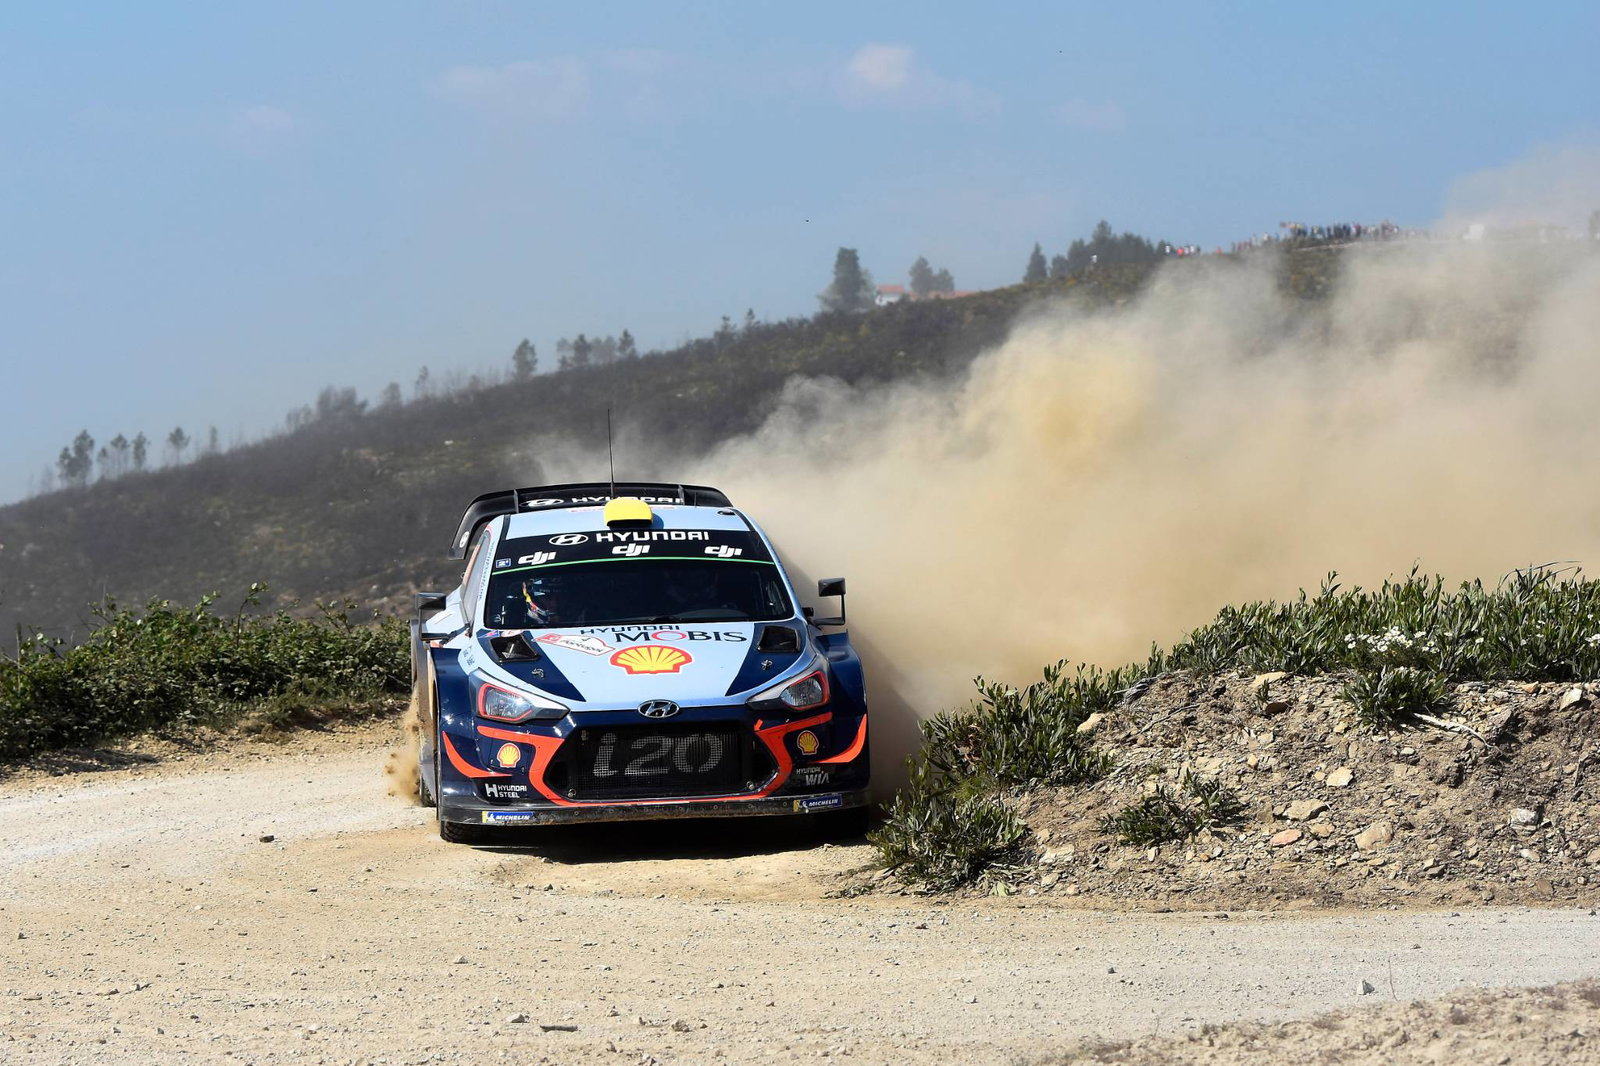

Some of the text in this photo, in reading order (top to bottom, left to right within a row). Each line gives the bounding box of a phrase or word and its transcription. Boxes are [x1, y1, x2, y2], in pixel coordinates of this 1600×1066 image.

[596, 531, 709, 542] HYUNDAI
[580, 625, 680, 635] HYUNDAI
[615, 631, 748, 642] MOBIS
[796, 767, 821, 775] HYUNDAI
[498, 784, 527, 792] HYUNDAI
[809, 798, 839, 807] MICHELIN
